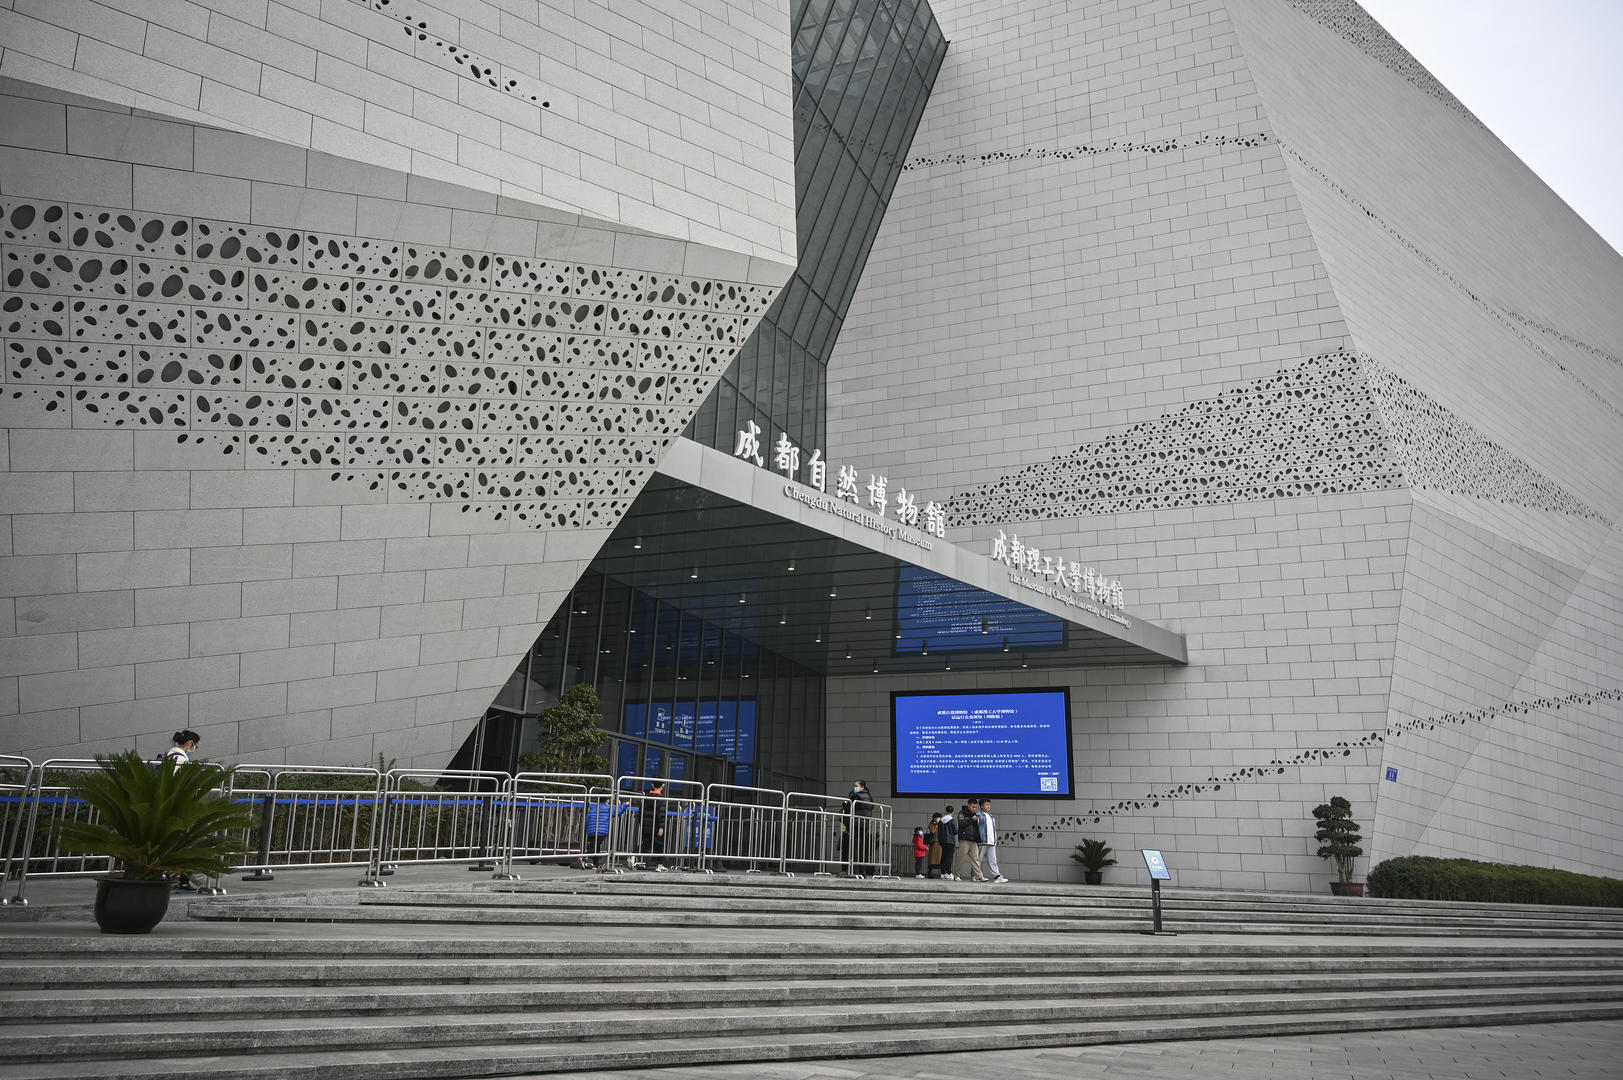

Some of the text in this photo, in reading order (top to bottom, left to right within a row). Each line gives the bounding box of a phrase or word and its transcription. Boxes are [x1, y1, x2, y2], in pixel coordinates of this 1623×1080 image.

[734, 420, 945, 538] 成都自然博物館
[784, 484, 933, 551] Chengdu Natural History Museum
[992, 529, 1124, 610] 成都理工大學博物館
[1008, 571, 1020, 585] The
[1021, 577, 1045, 595] Museum
[1052, 589, 1076, 606] Chengdu
[1075, 597, 1100, 617] University
[1106, 609, 1131, 629] Technology
